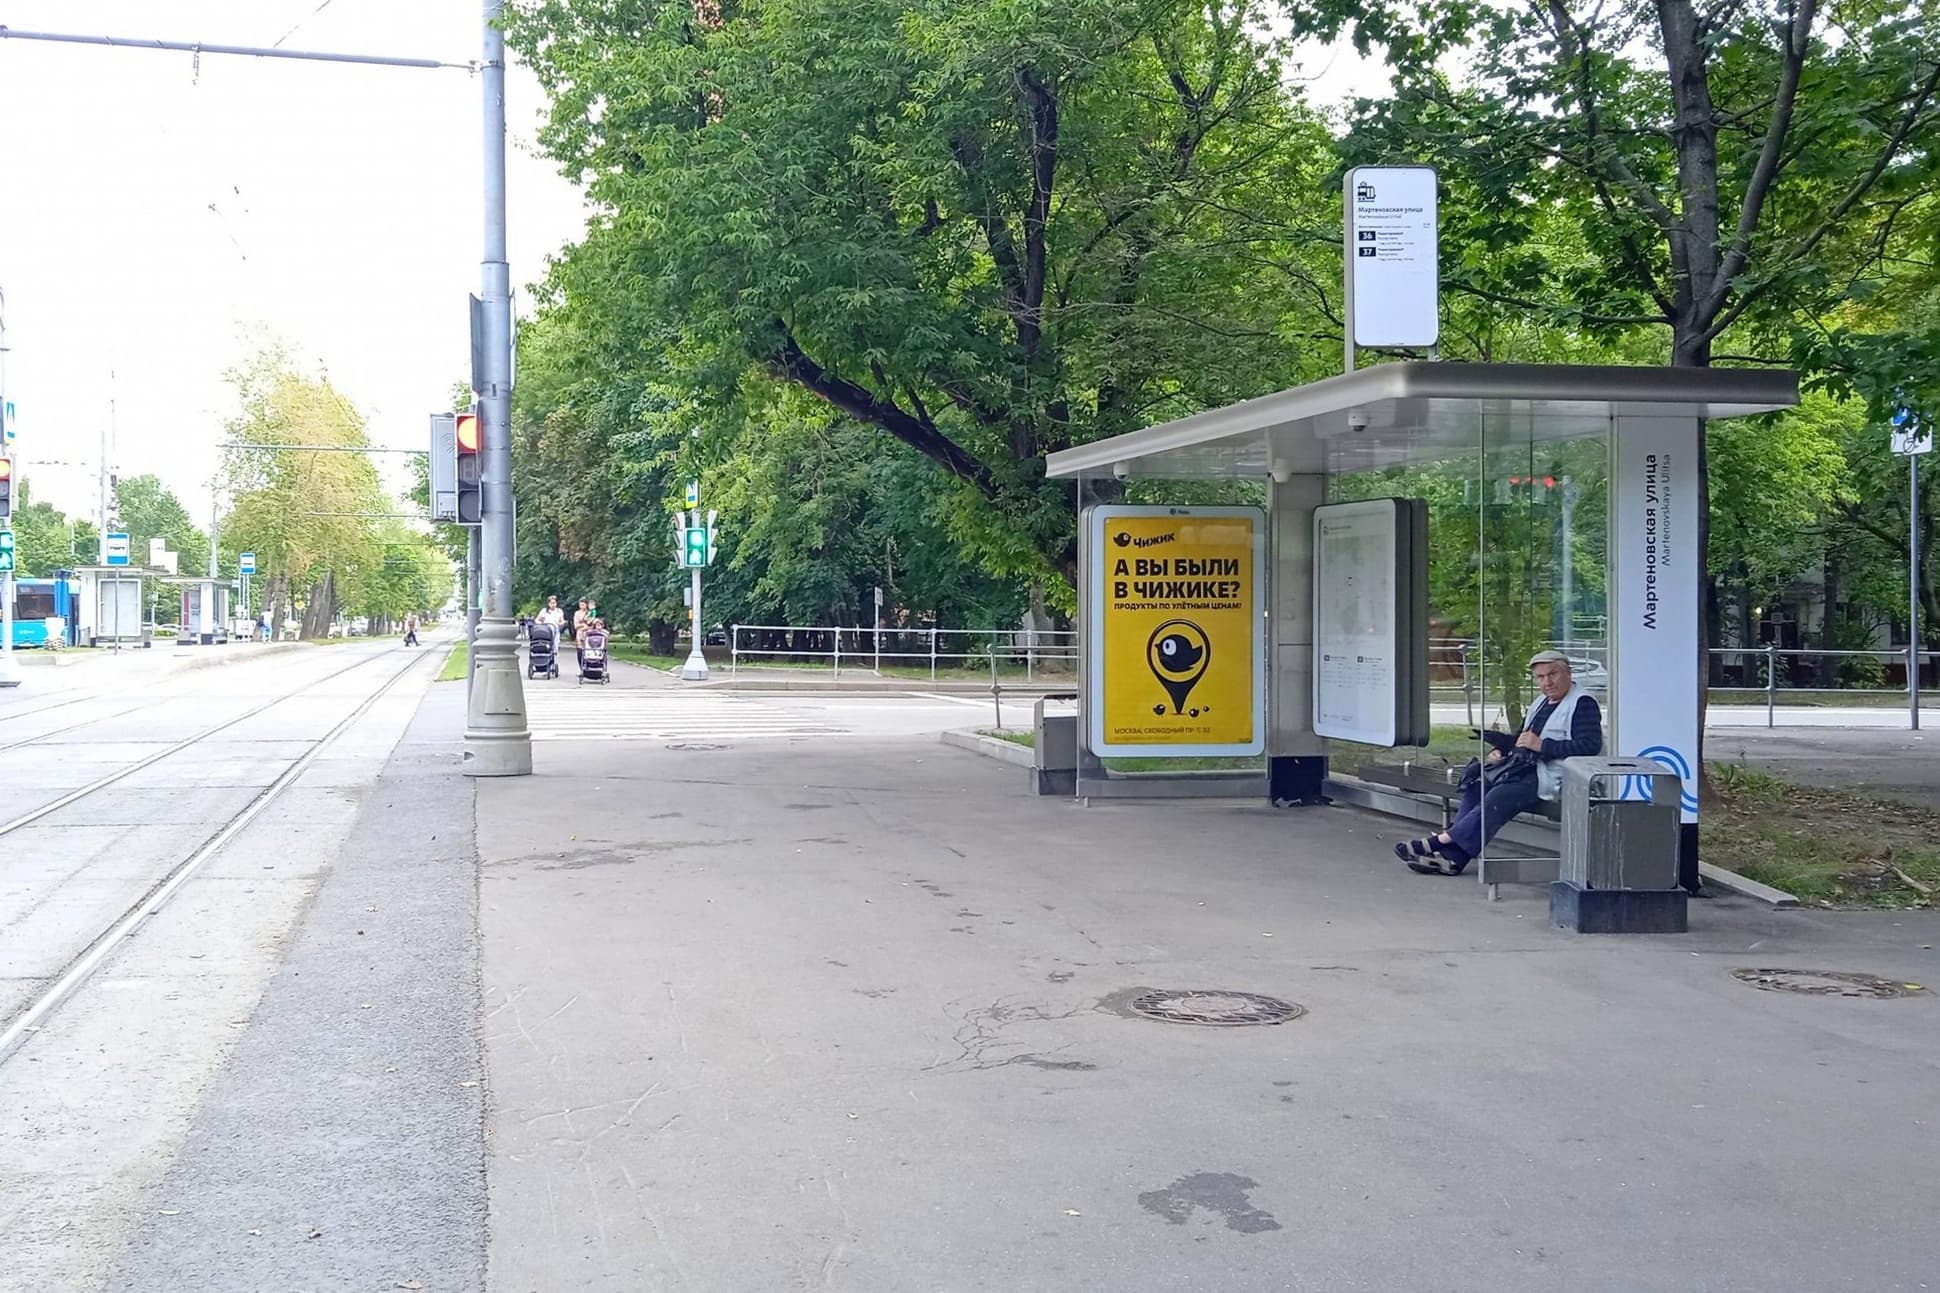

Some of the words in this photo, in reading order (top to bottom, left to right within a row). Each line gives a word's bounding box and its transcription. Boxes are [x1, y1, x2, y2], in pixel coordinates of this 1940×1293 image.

[1646, 455, 1659, 503] улица
[1661, 454, 1671, 483] Ulitsa
[1661, 486, 1672, 566] Martenovskaya
[1114, 559, 1129, 576] А
[1136, 559, 1168, 576] ВЫ
[1175, 559, 1239, 576] БЫЛИ
[1643, 509, 1659, 629] Мартеновская
[1114, 581, 1127, 598] В
[1134, 581, 1240, 598] ЧИЖИКЕ?
[1211, 602, 1241, 610] ЦЕНАМ!
